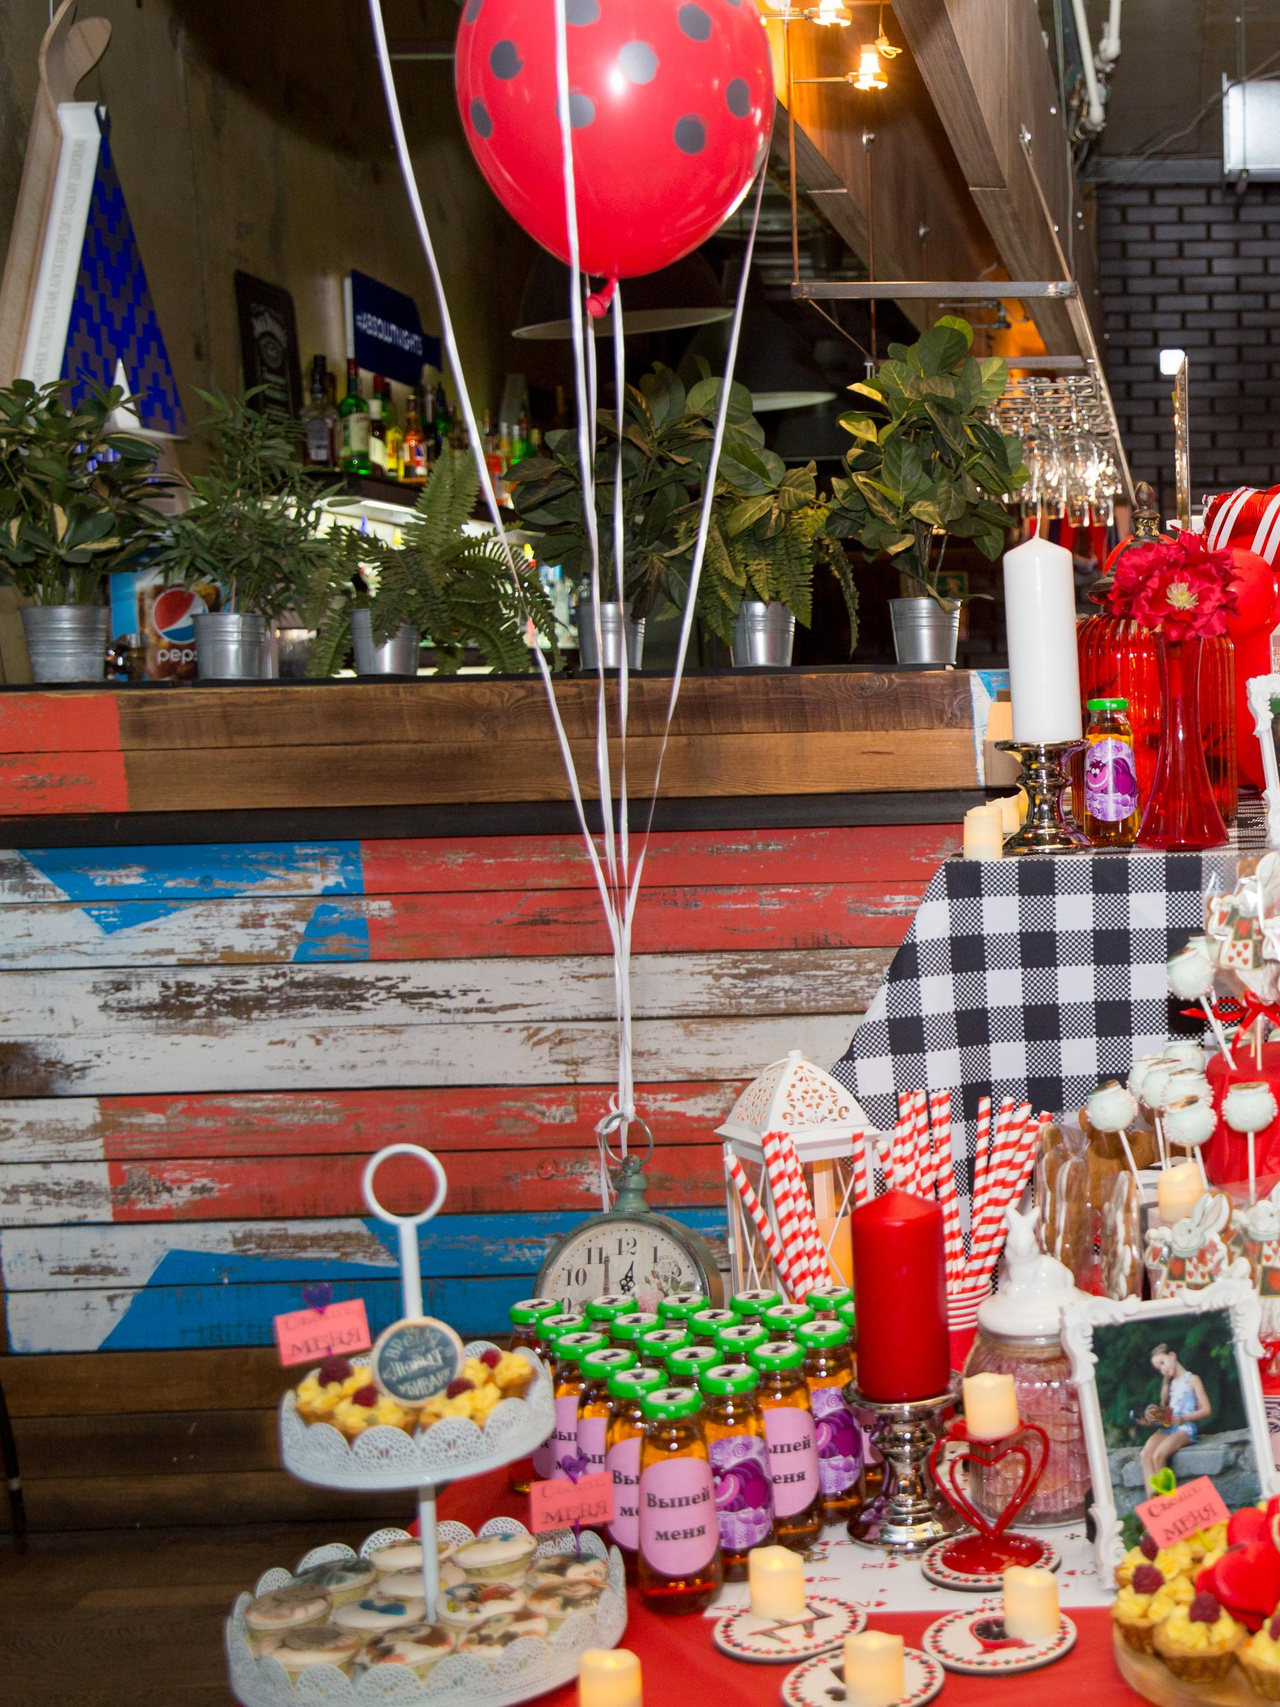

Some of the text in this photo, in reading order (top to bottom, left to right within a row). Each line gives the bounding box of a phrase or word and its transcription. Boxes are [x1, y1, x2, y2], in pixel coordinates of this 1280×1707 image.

[585, 1246, 604, 1264] 11
[617, 1237, 637, 1256] 12
[565, 1267, 587, 1286] 10
[646, 1486, 711, 1509] Выпей
[655, 1525, 706, 1541] меня
